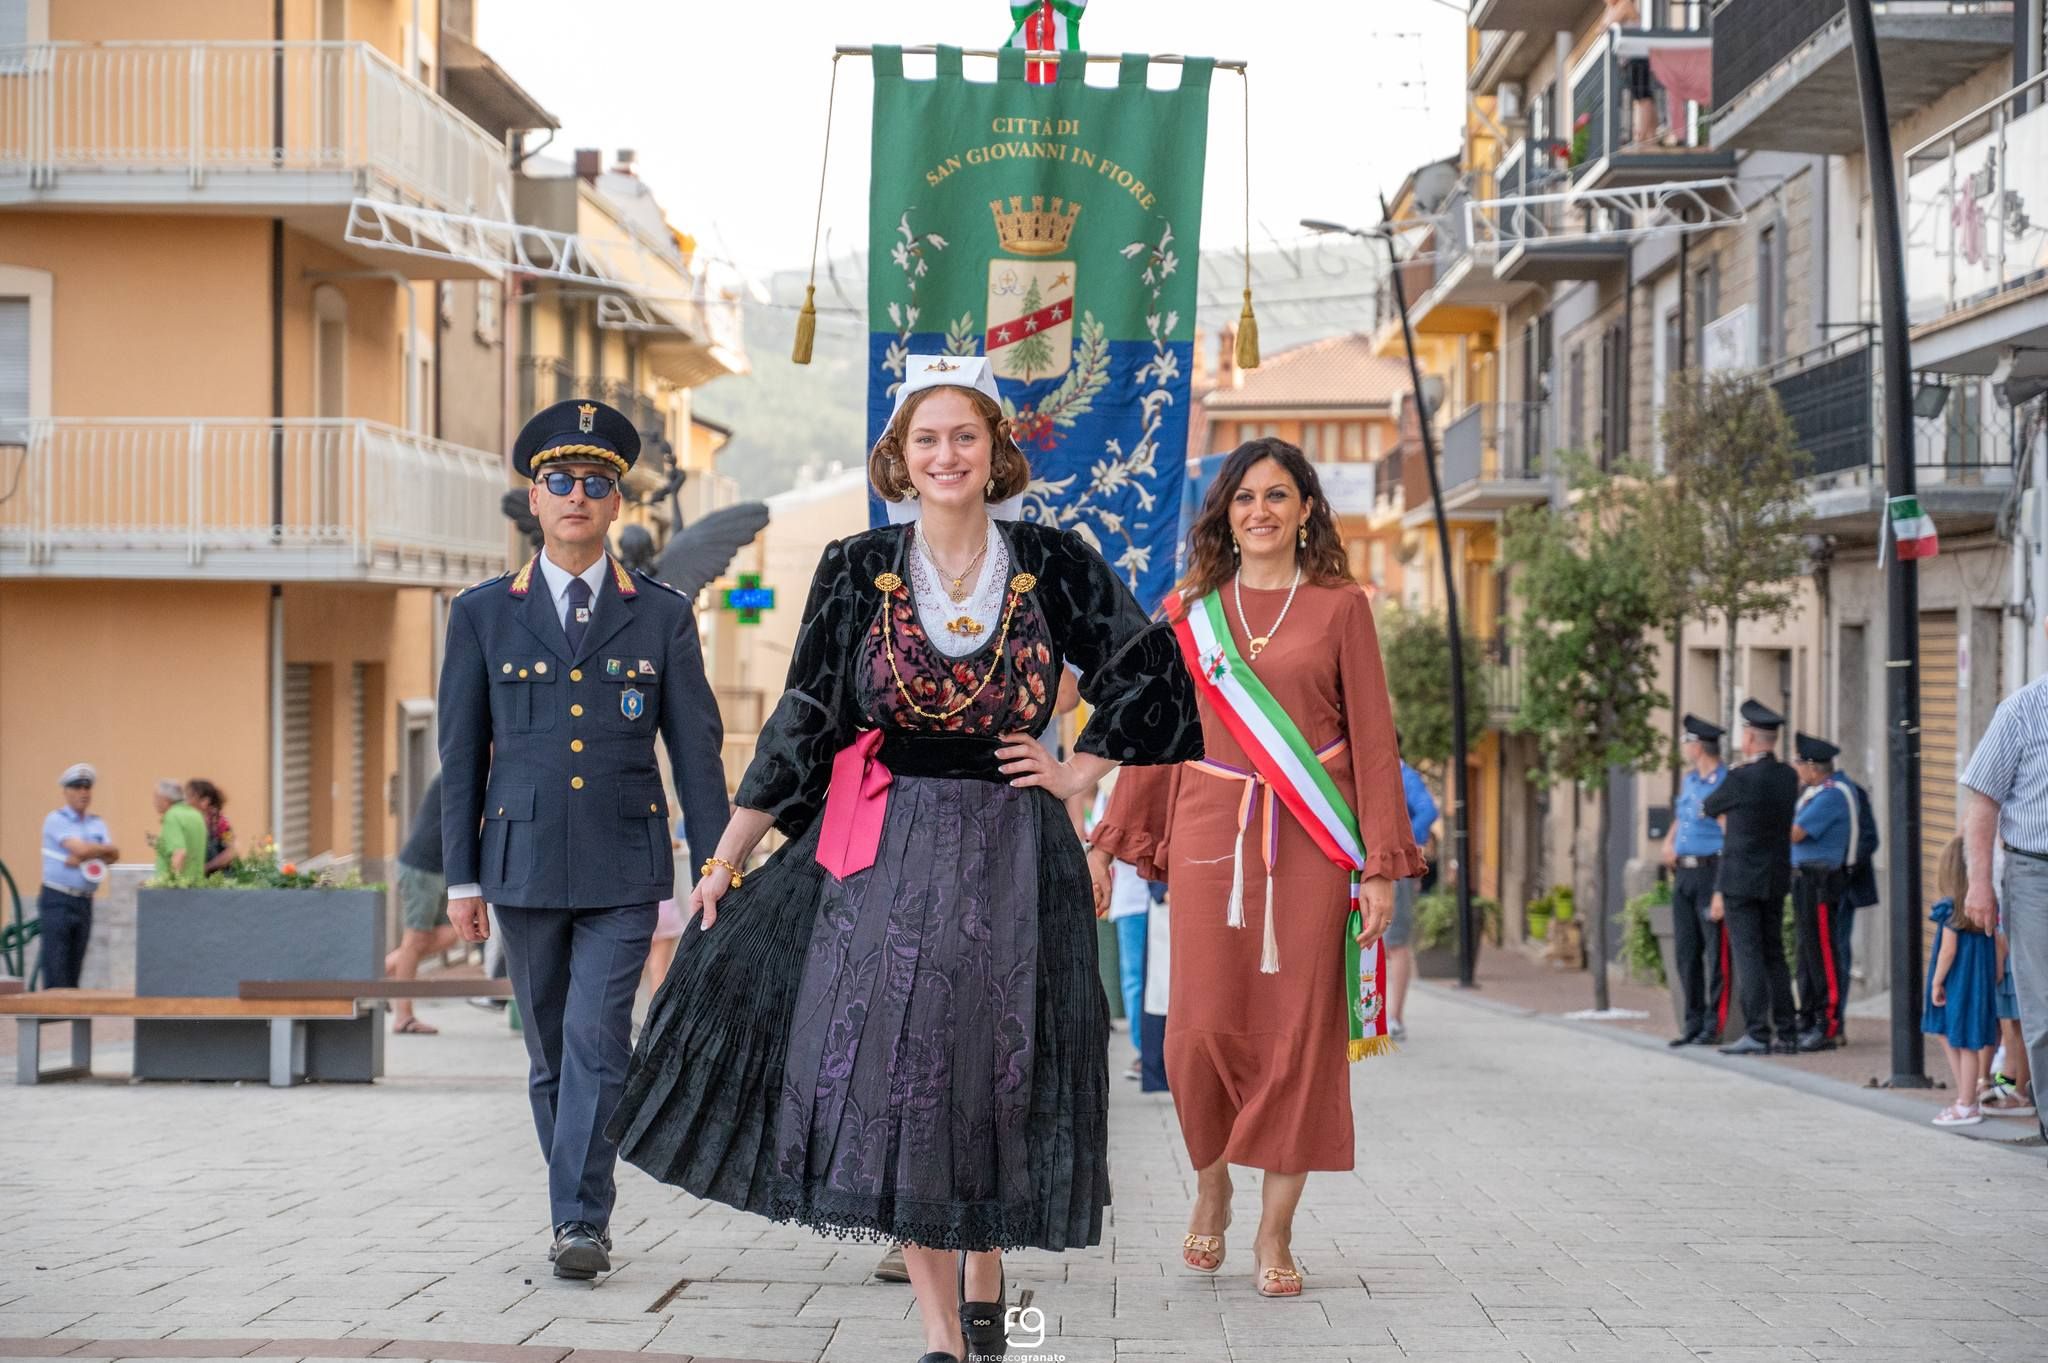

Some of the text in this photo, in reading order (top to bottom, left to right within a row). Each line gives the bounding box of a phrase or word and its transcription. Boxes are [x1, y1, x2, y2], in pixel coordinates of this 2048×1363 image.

[992, 117, 1080, 136] CITTÀ DI
[926, 141, 1157, 211] SAN GIOVANNI IN FIORE
